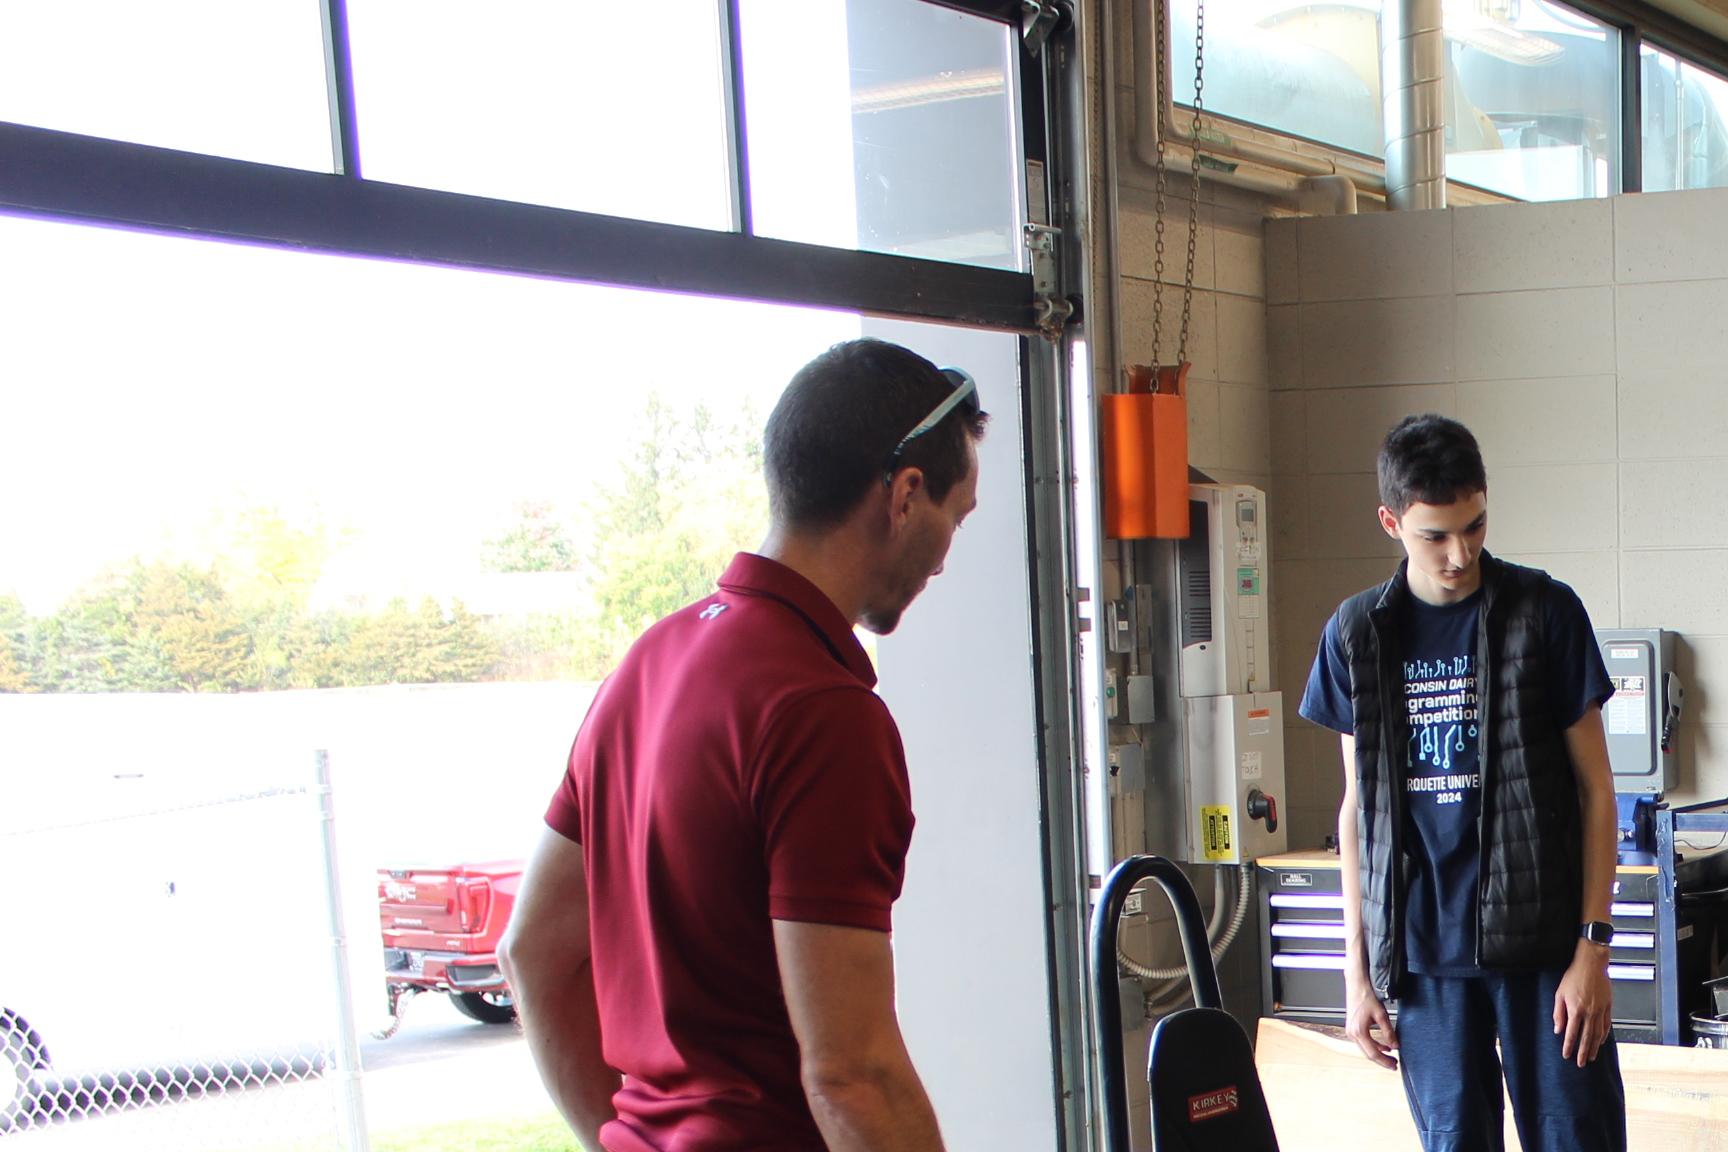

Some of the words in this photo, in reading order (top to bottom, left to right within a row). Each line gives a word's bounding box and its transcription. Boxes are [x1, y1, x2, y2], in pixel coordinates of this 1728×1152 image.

[1405, 690, 1478, 713] grammin
[1446, 774, 1480, 790] UNIVE
[1437, 792, 1462, 804] 2024
[1192, 1092, 1229, 1111] KIRKEY
